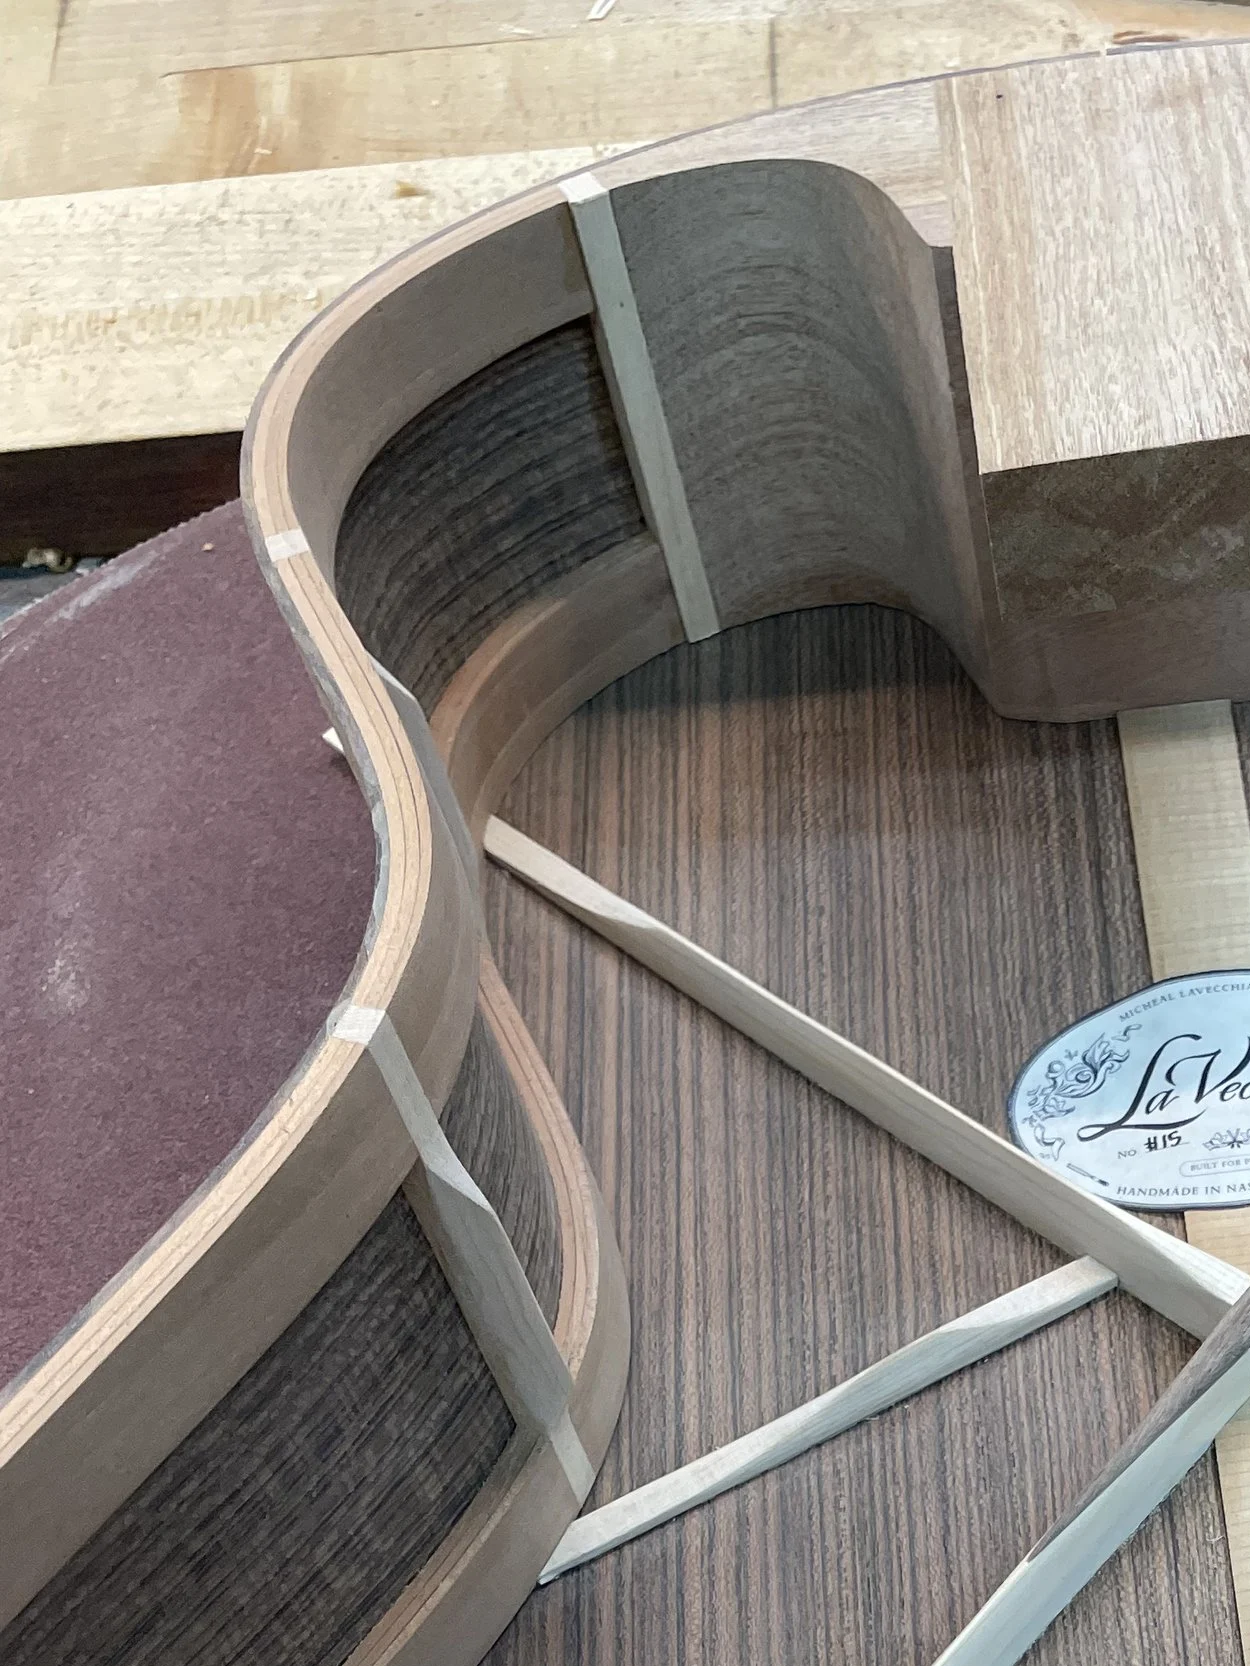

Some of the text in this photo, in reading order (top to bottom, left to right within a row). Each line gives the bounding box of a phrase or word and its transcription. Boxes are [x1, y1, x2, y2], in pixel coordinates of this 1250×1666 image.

[1119, 993, 1176, 1022] MICHEAL
[1144, 1131, 1182, 1153] #15
[1190, 1160, 1218, 1171] BUILT
[1222, 1159, 1241, 1168] FOR
[1116, 1185, 1199, 1197] HANDMADE
[1204, 1185, 1221, 1195] IN
